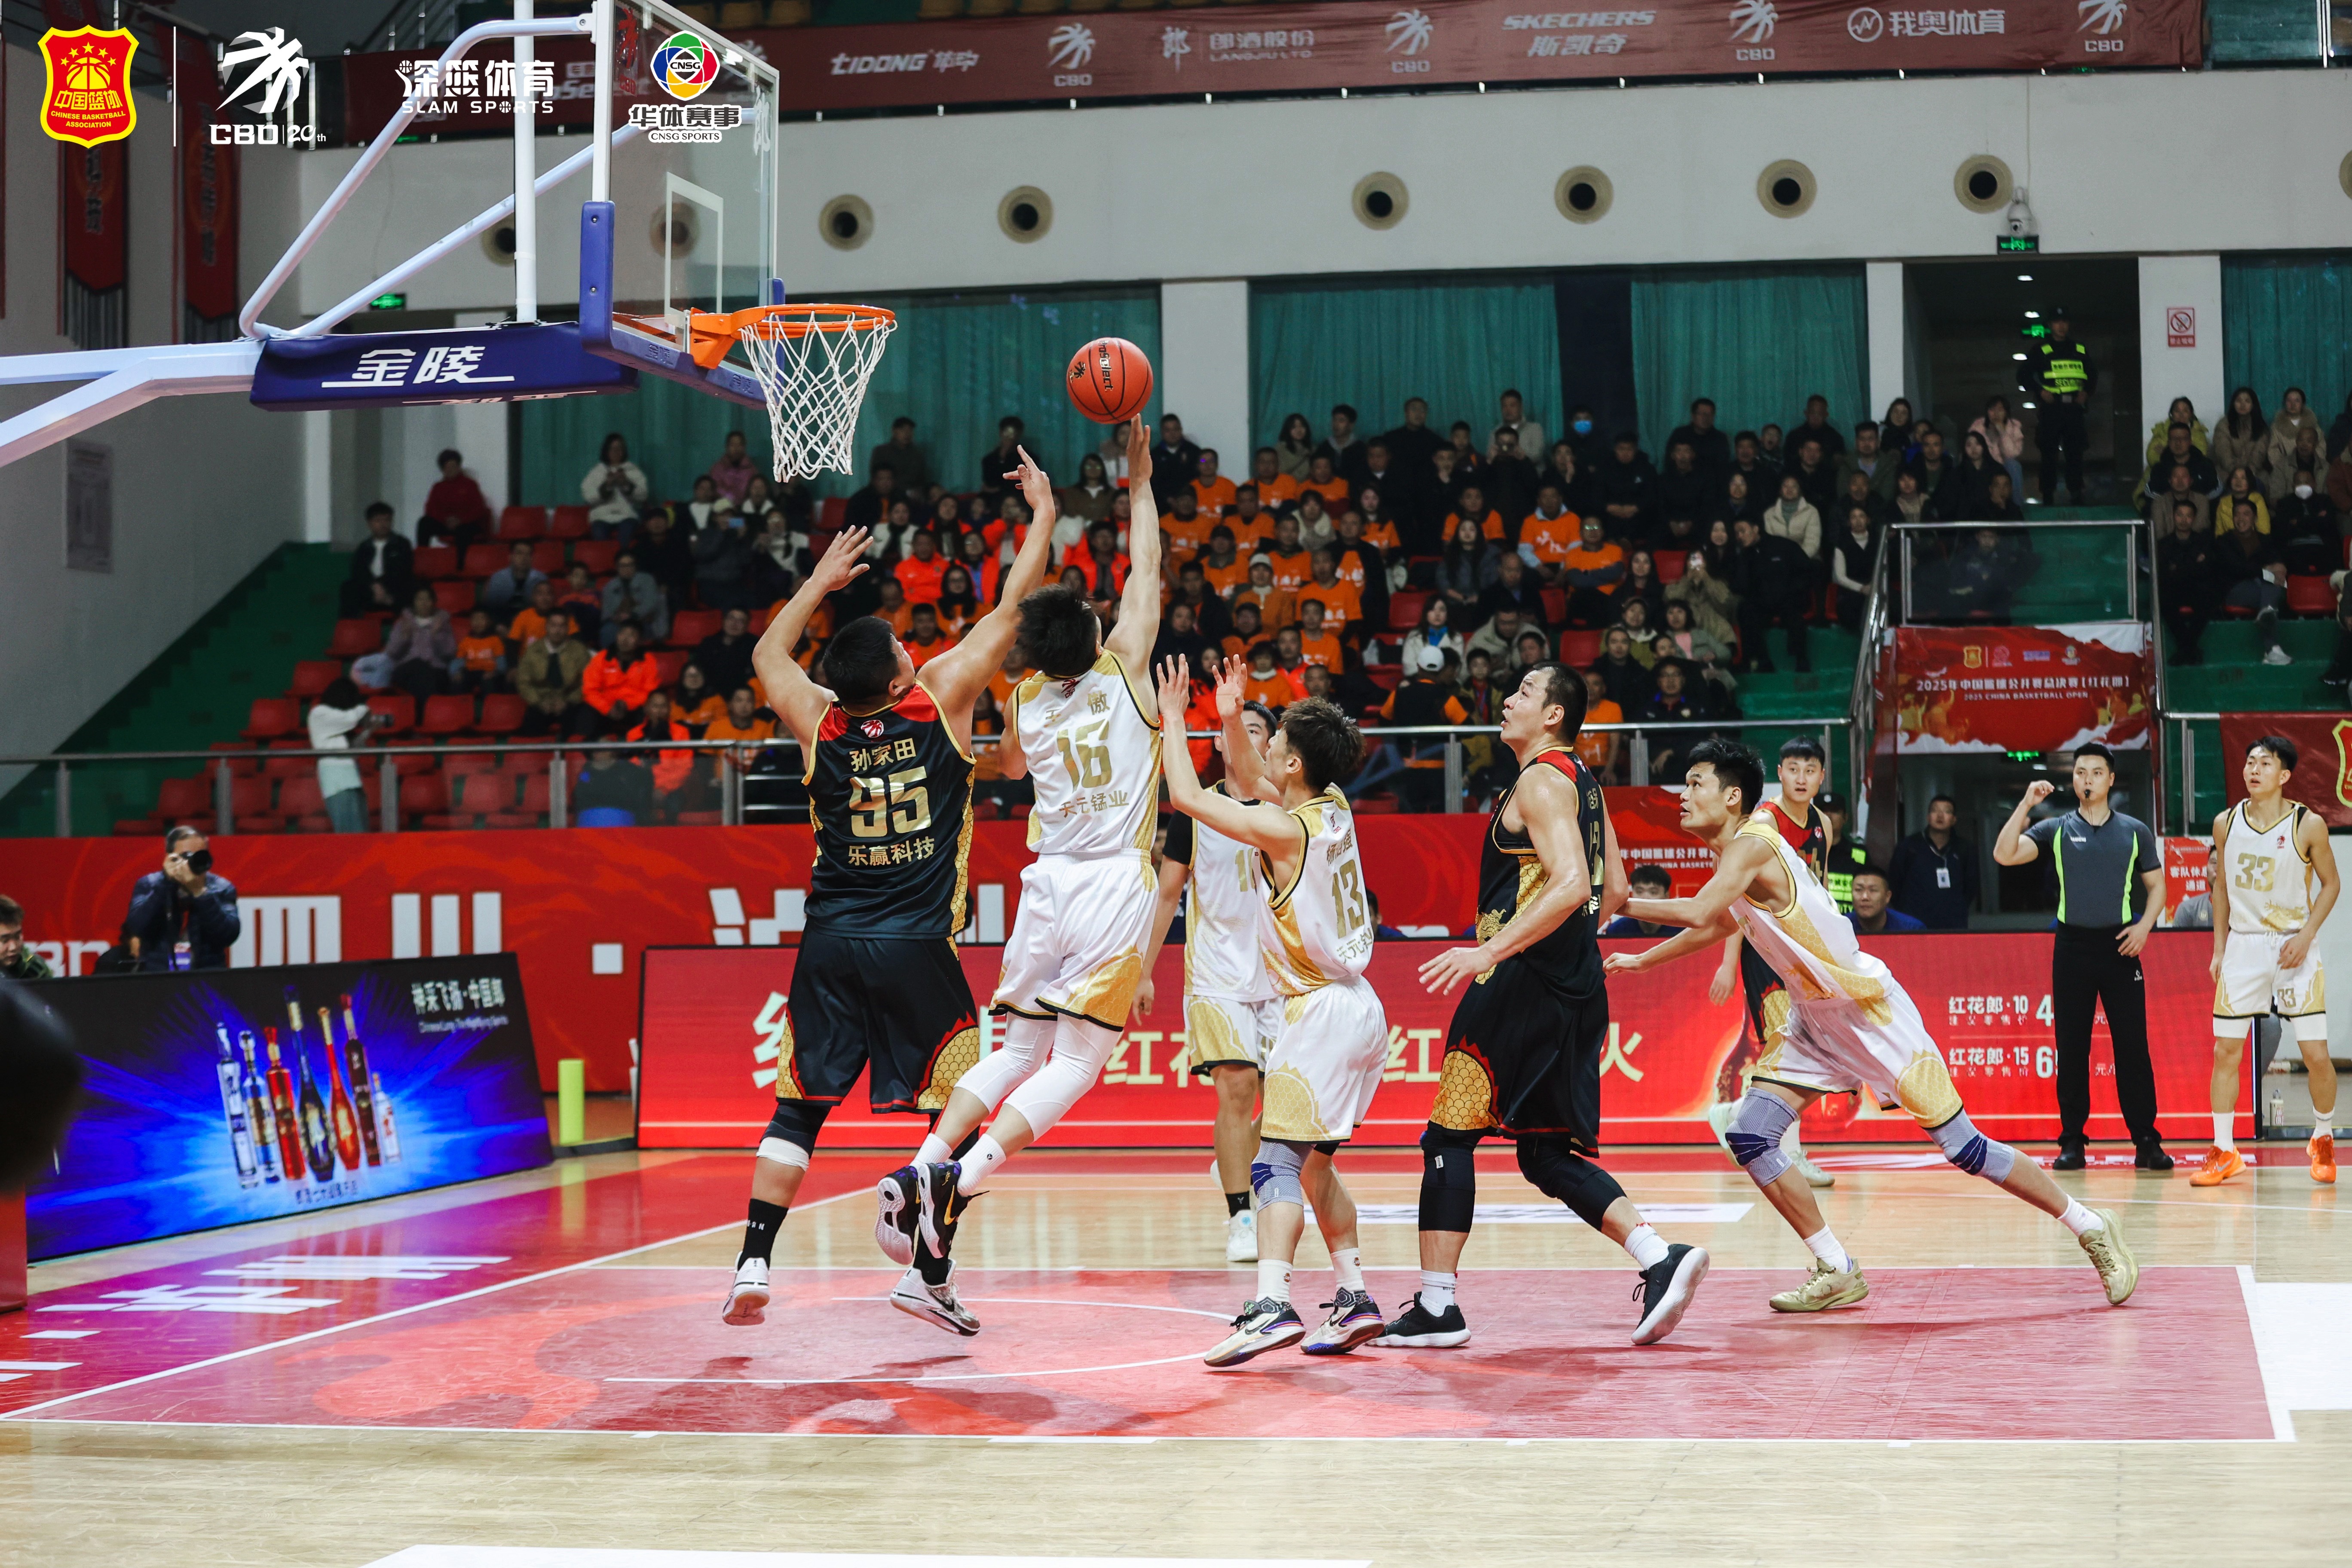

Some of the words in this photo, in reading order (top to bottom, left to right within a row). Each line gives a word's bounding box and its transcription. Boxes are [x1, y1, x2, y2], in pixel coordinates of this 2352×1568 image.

[1502, 11, 1656, 30] SKECHERS
[1889, 9, 2005, 36] 我奥体育
[1528, 34, 1628, 57] 斯凯奇
[322, 346, 515, 388] 金陵
[848, 738, 916, 772] 孙家田
[1057, 719, 1112, 793] 16
[849, 766, 931, 837] 95
[1059, 790, 1129, 818] 天元锰业
[848, 836, 935, 866] 乐赢科技
[2236, 852, 2275, 892] 33
[1332, 859, 1365, 939] 13
